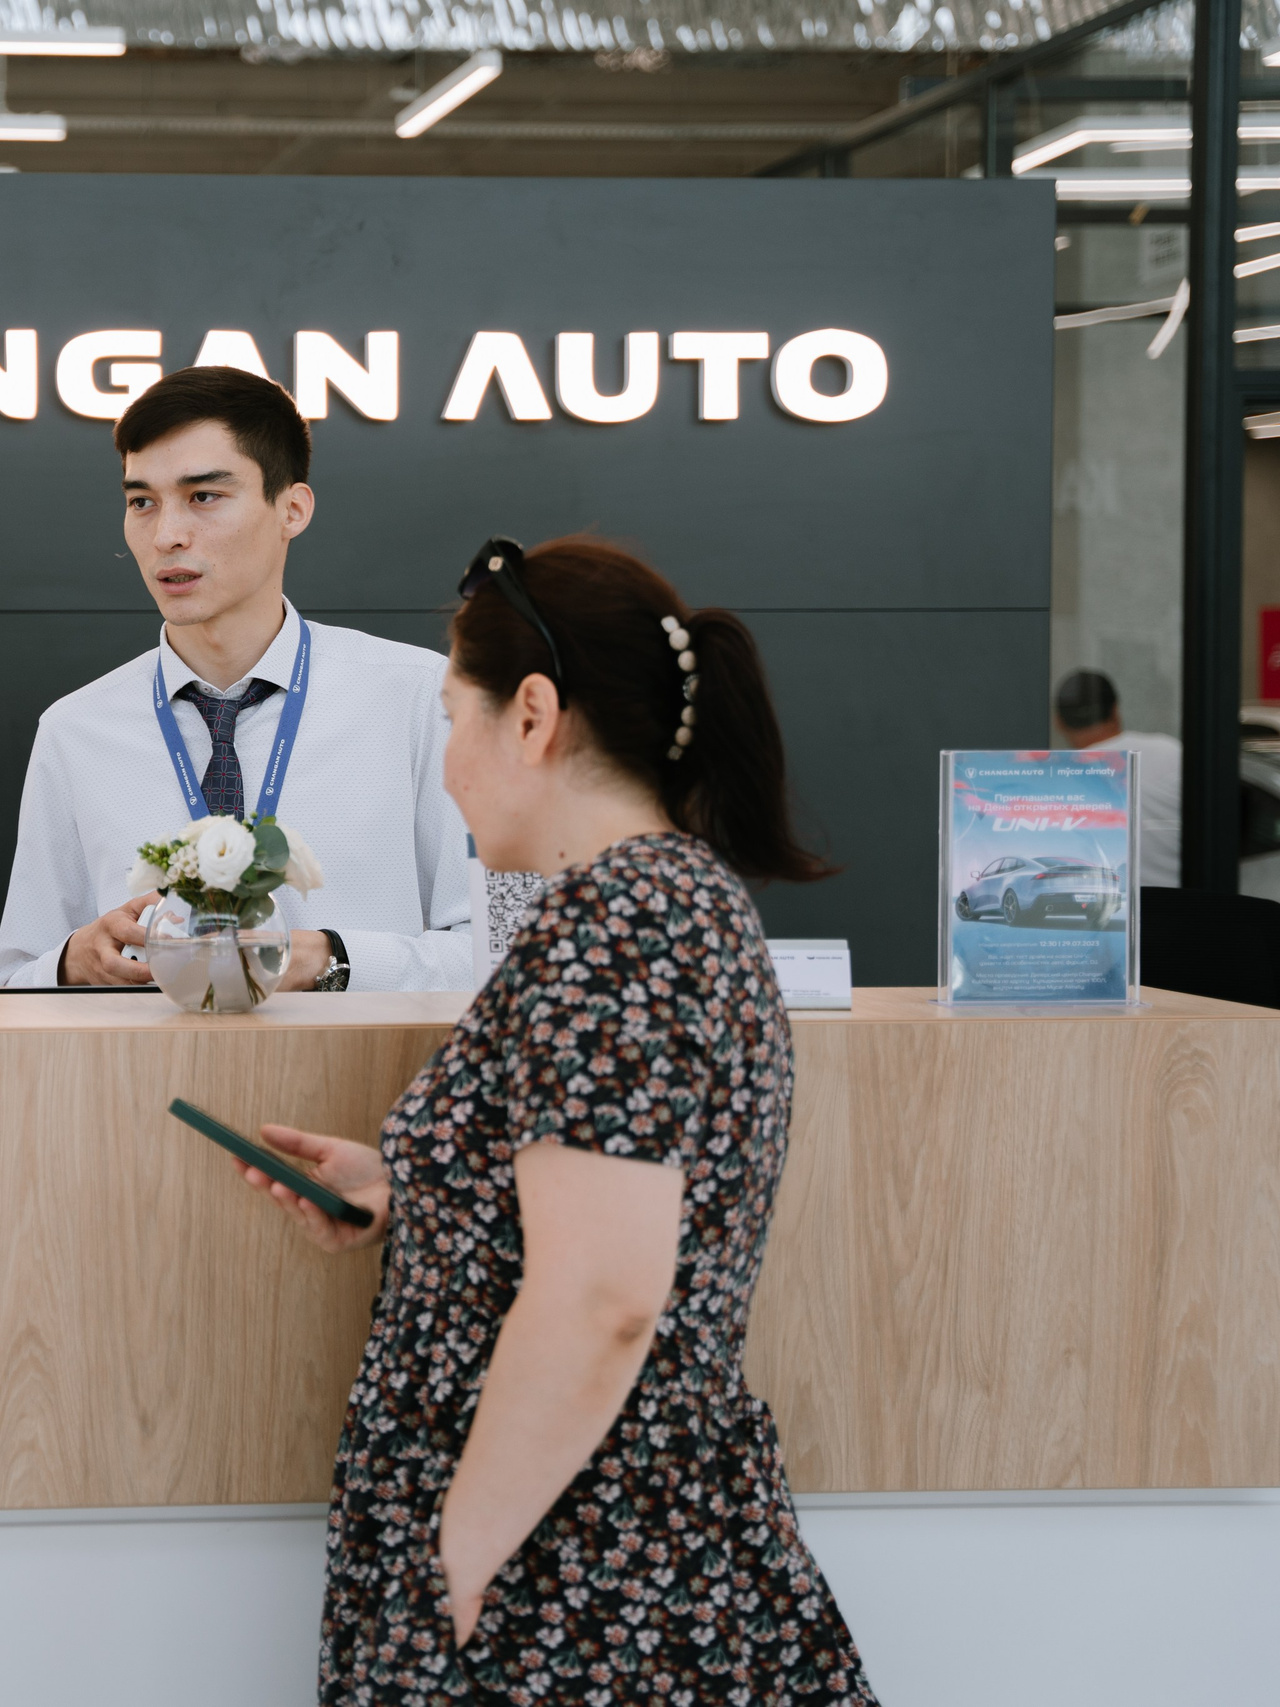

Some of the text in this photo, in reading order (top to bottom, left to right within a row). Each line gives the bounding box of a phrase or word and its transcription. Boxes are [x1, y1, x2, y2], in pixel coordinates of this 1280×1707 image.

[440, 328, 888, 423] AUTO
[269, 738, 286, 786] CHANGAN AUTO
[176, 751, 194, 796] CHANGAN AUTO
[1085, 767, 1116, 777] almaty
[994, 794, 1086, 803] Приглашаем вас
[983, 803, 1011, 812] День
[1013, 804, 1069, 812] открытых
[1070, 802, 1112, 812] дверей
[992, 816, 1087, 832] UNI-V
